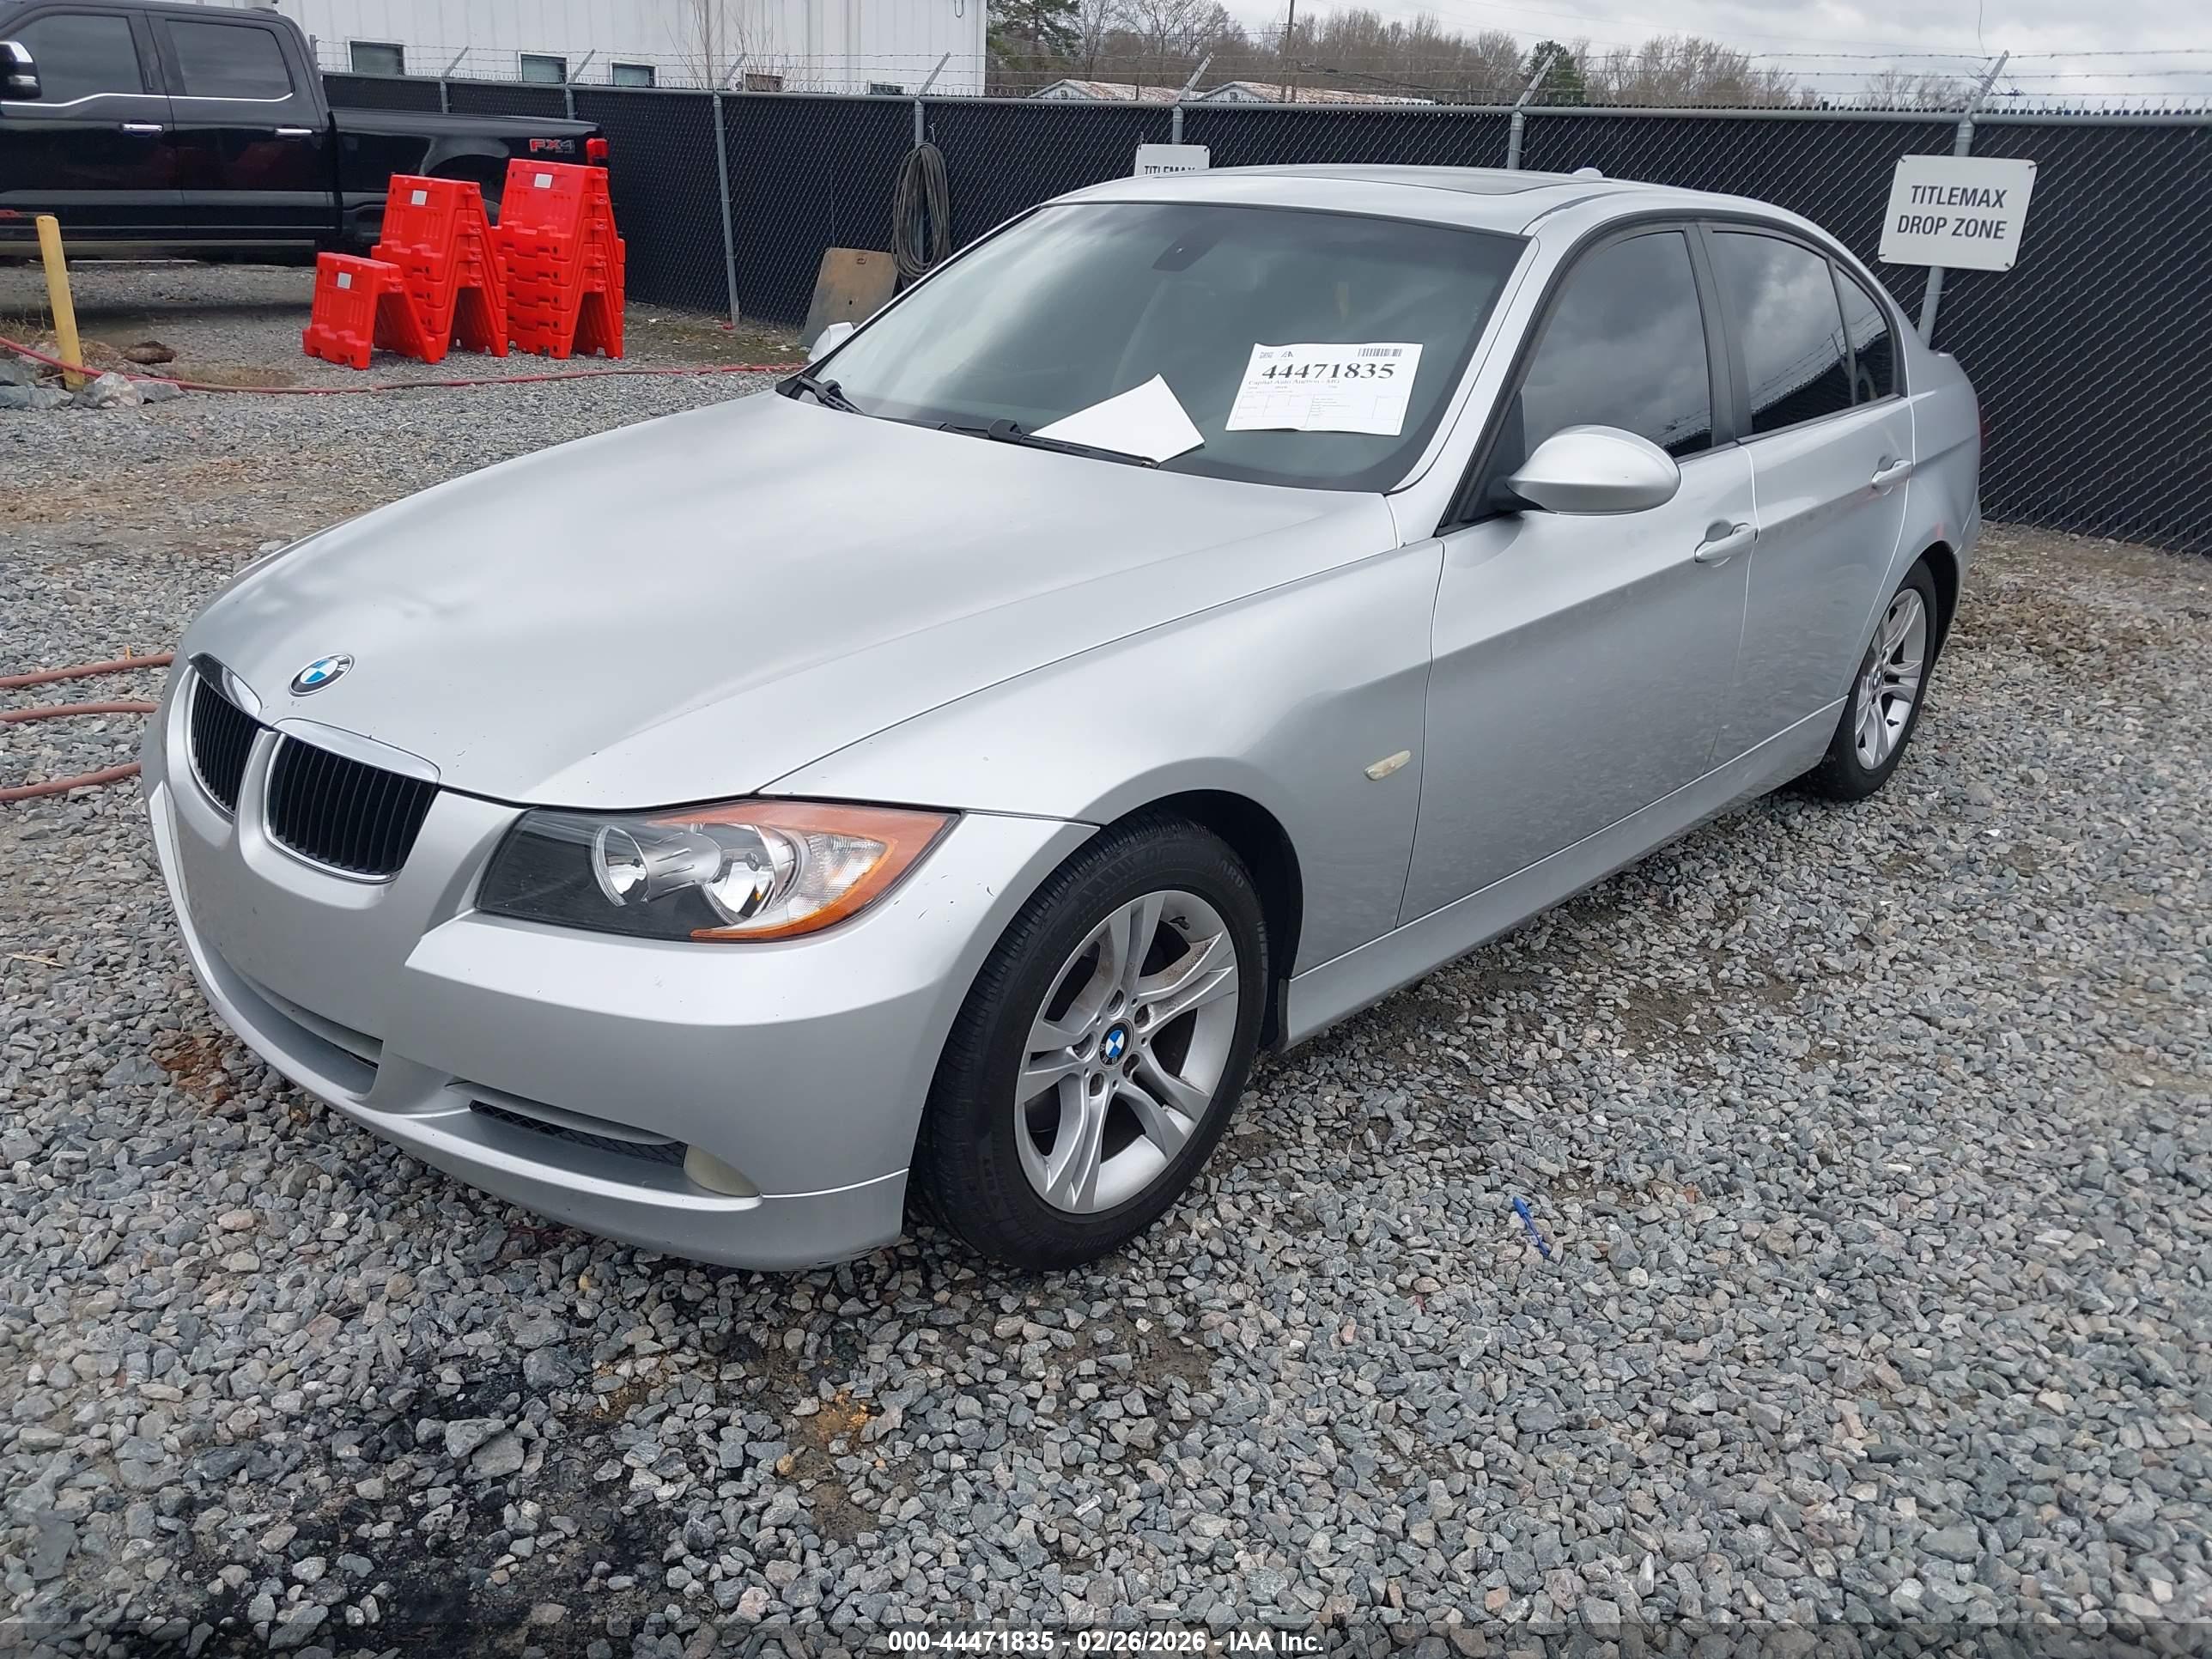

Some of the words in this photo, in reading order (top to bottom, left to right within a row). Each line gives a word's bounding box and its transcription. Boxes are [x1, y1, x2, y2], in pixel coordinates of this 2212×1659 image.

[529, 138, 575, 153] FX4
[1911, 185, 2008, 209] TITLEMAX
[1897, 215, 1948, 235] DROP
[1952, 218, 2008, 240] ZONE
[1261, 362, 1396, 380] 44471835
